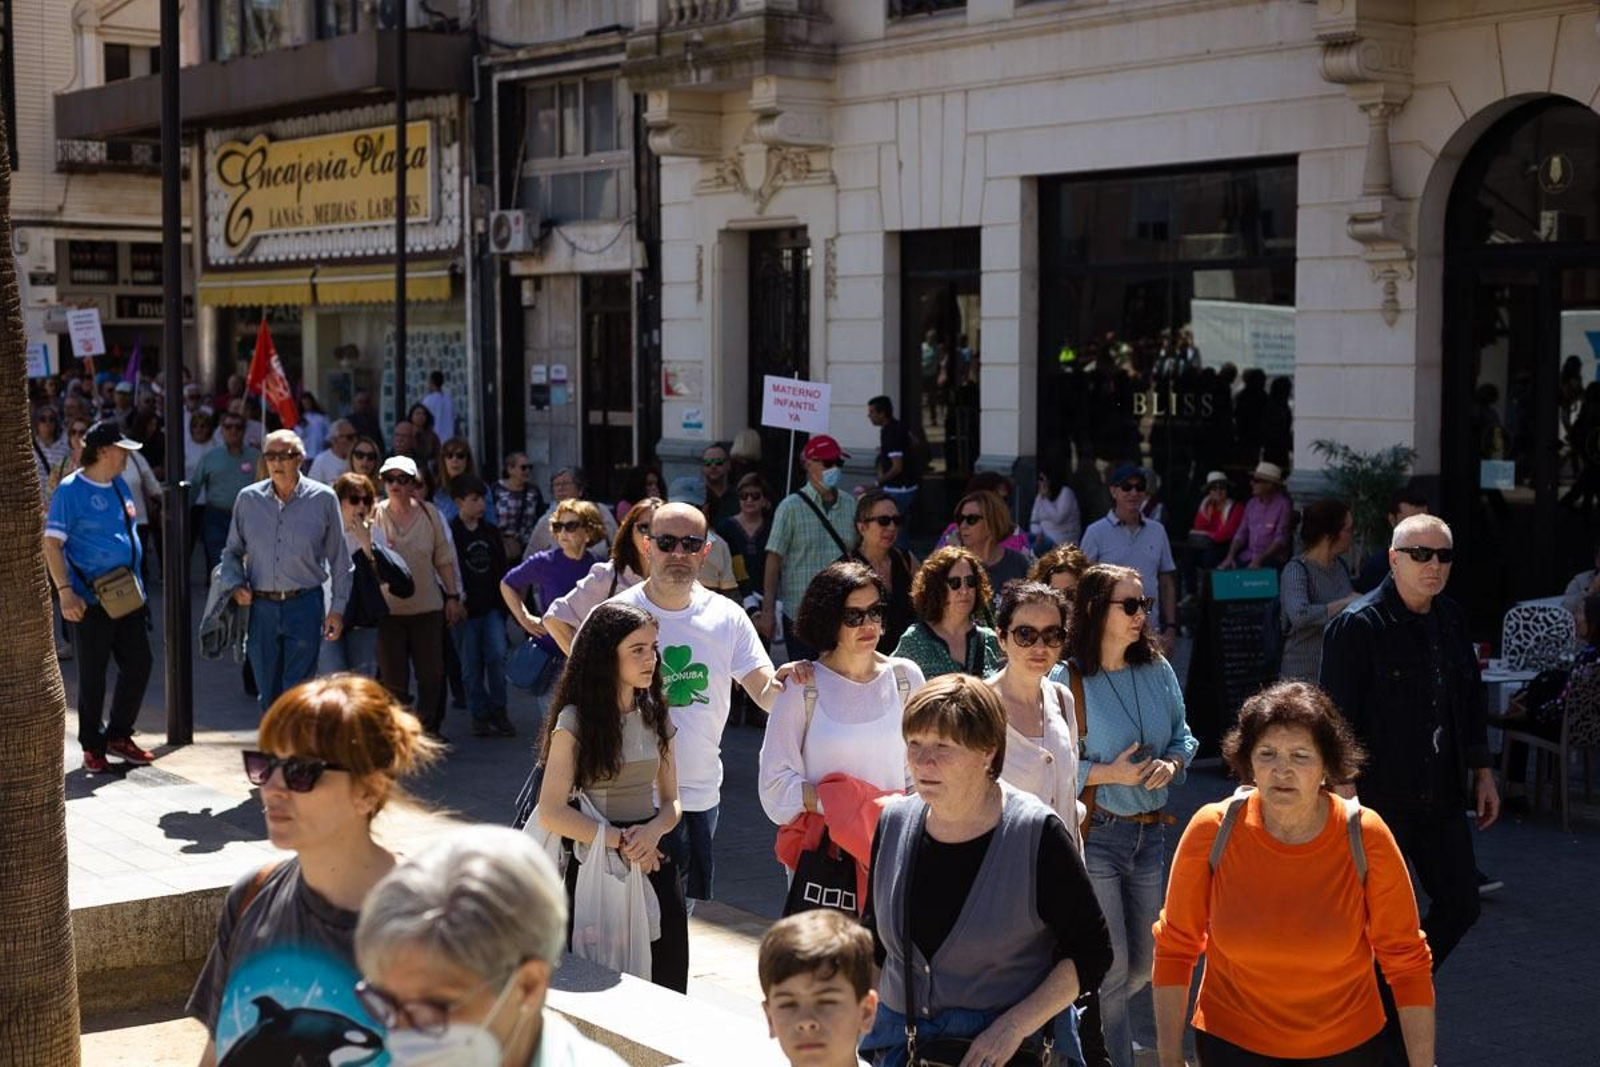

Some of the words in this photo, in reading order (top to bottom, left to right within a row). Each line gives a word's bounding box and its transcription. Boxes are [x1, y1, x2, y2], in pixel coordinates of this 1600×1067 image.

[772, 384, 821, 399] MATERNO
[774, 397, 818, 412] INFANTIL
[1132, 392, 1214, 417] BLISS
[788, 413, 801, 422] YA
[662, 671, 704, 685] ERONUBA
